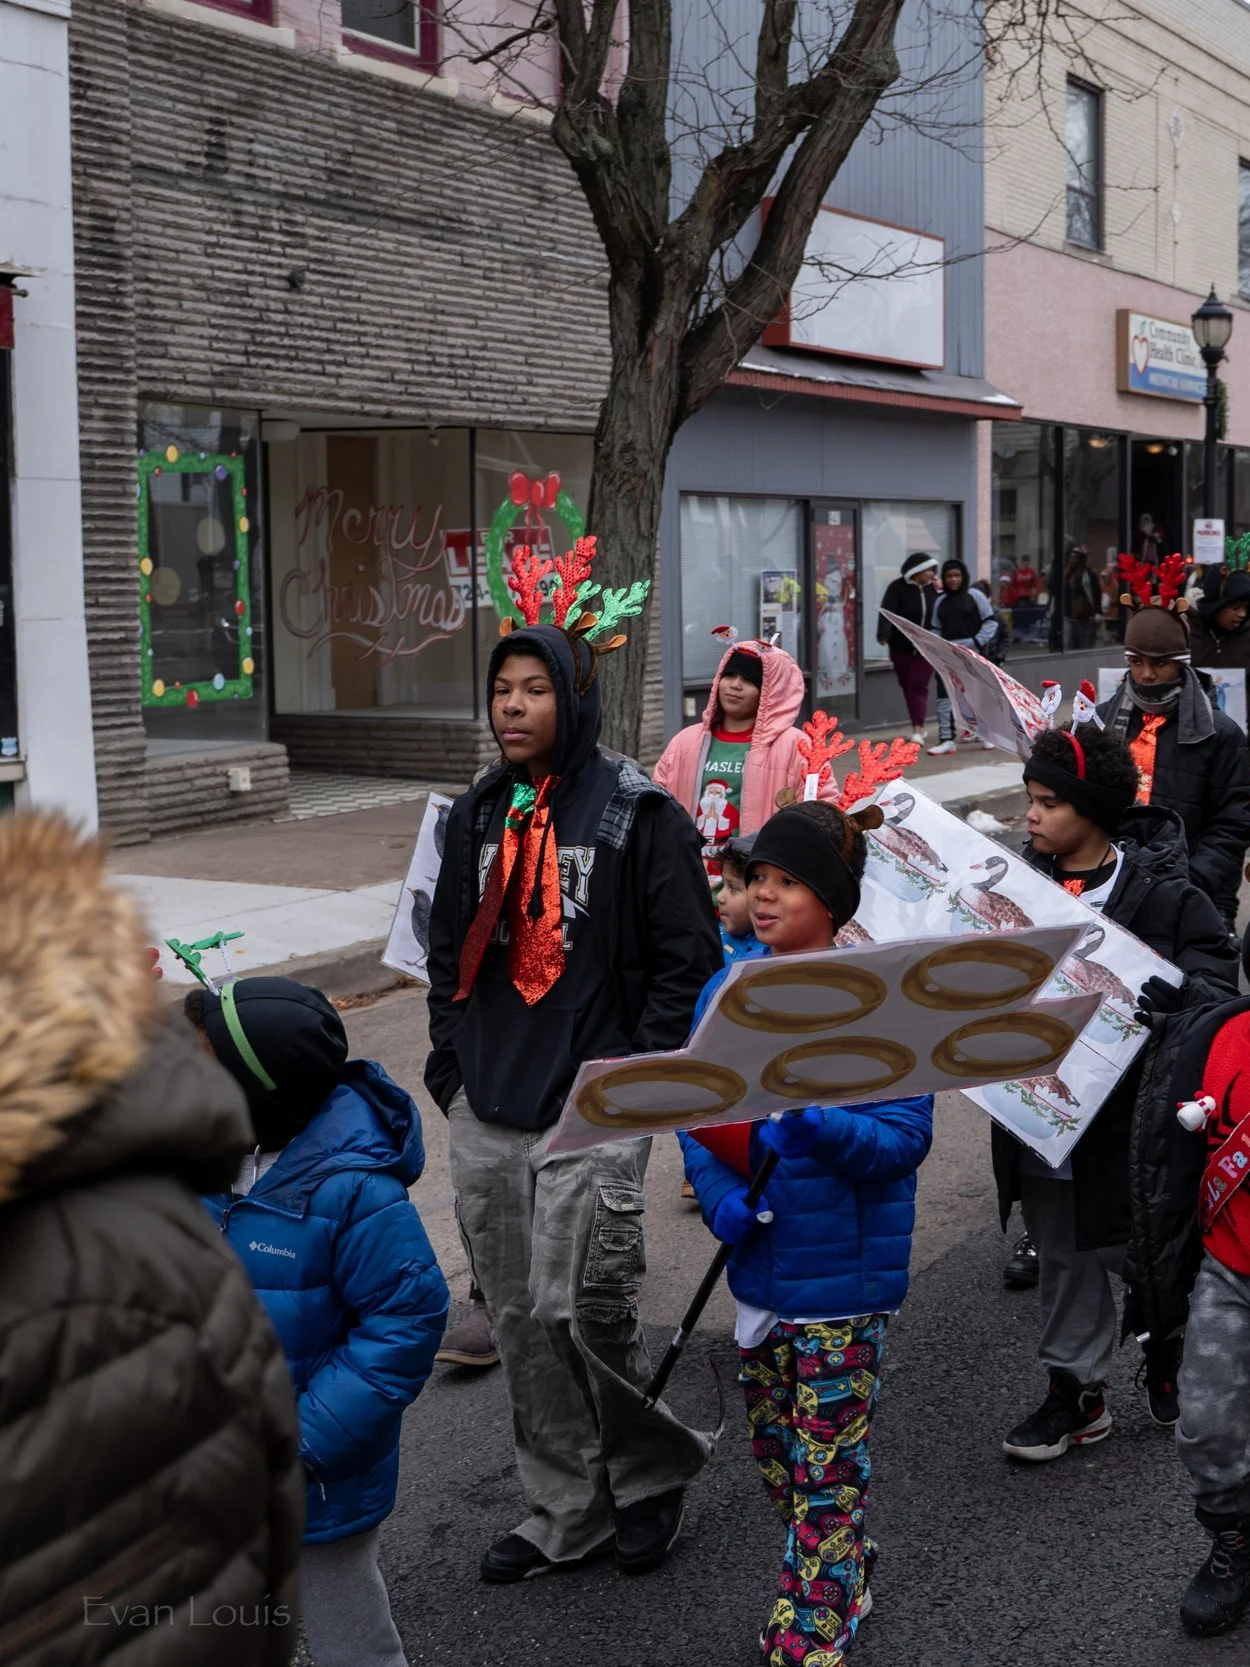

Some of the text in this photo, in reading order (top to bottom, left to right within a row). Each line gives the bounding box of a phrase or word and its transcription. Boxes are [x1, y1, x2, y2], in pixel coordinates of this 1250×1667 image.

[295, 484, 443, 572] Merry
[280, 550, 466, 638] Christmas
[257, 1242, 296, 1259] Columbia
